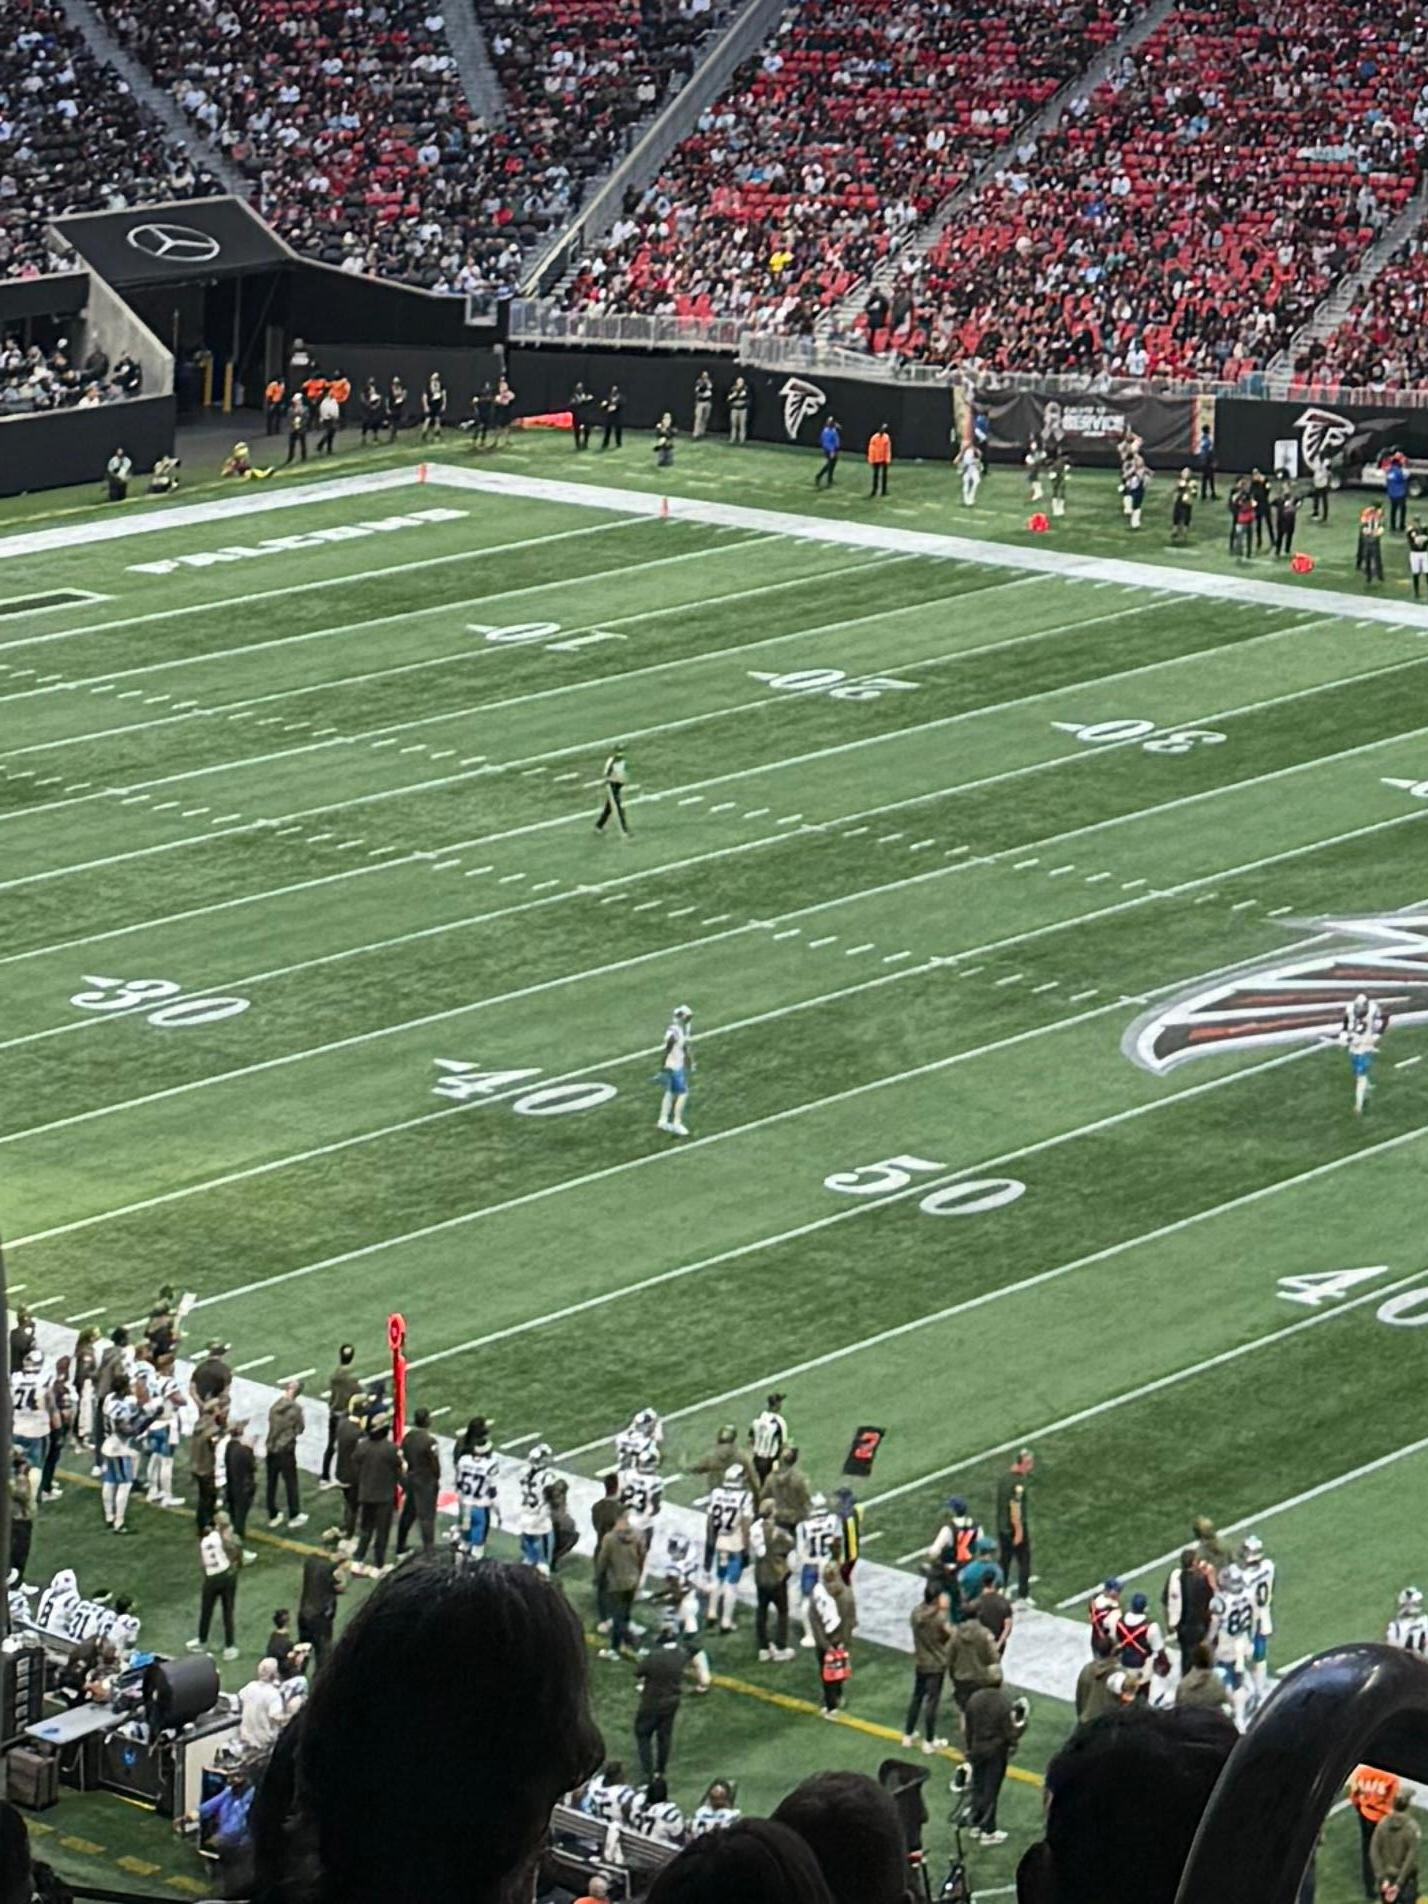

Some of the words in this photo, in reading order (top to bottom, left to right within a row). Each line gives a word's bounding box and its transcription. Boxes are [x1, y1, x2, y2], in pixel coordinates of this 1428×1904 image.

[126, 507, 470, 575] FALCONS
[69, 978, 249, 1027] 30
[431, 1065, 617, 1115] 40
[823, 1154, 1025, 1214] 50
[856, 1432, 879, 1459] 2
[1229, 1607, 1252, 1635] 82
